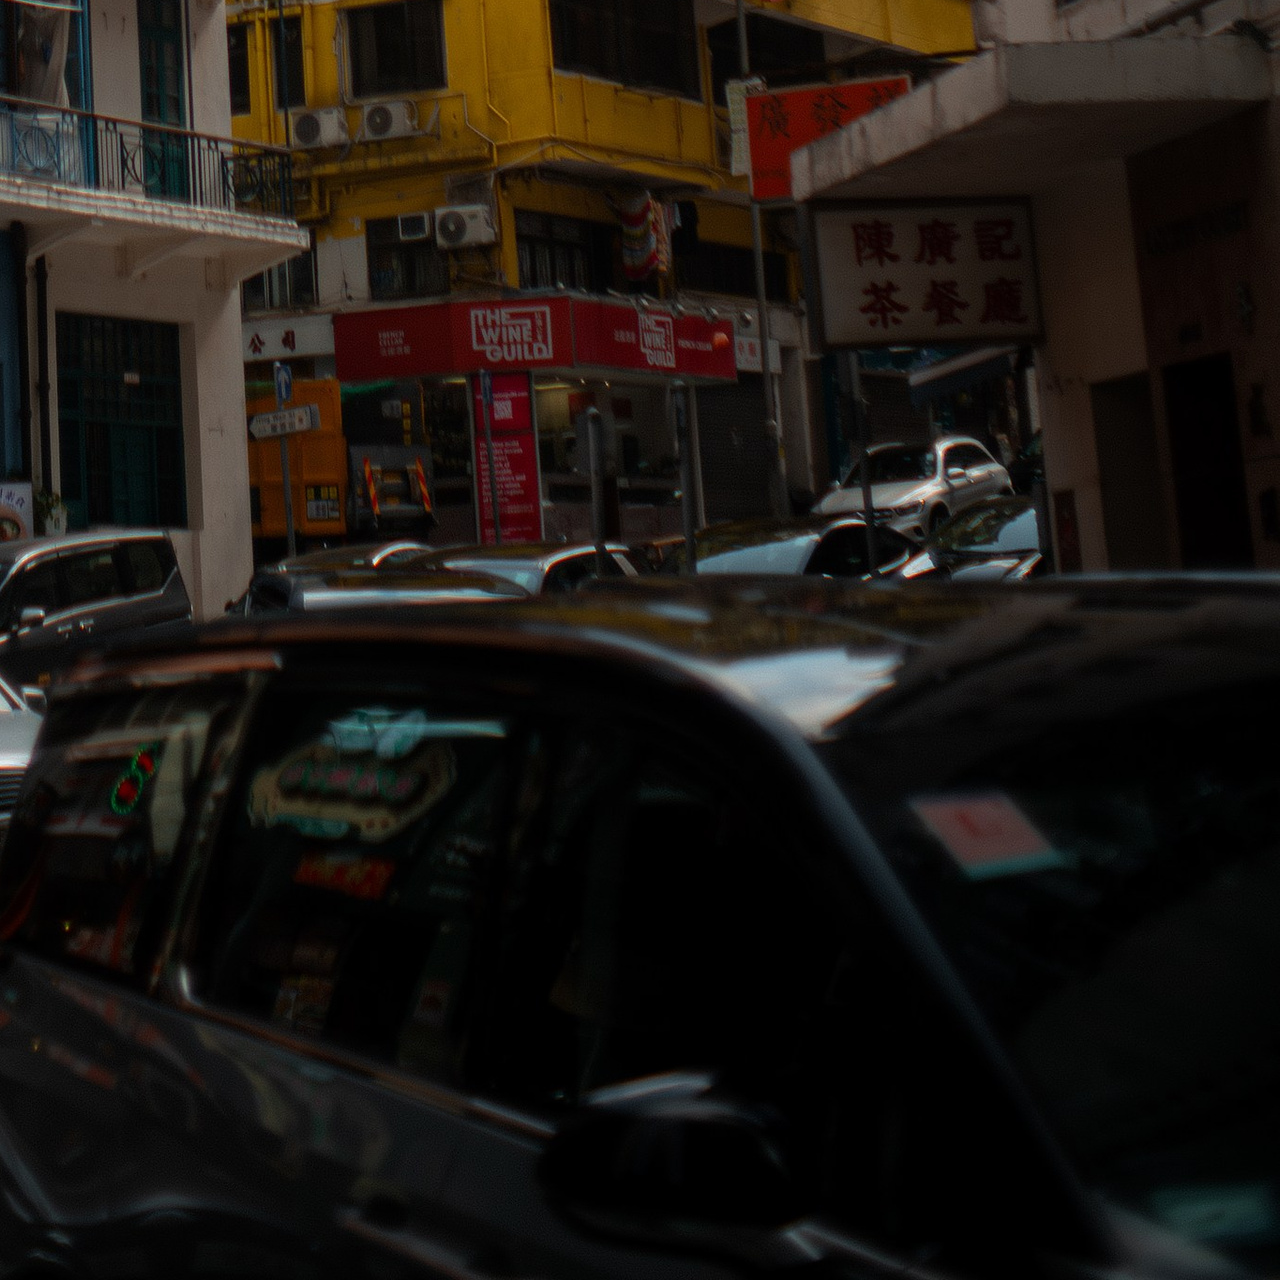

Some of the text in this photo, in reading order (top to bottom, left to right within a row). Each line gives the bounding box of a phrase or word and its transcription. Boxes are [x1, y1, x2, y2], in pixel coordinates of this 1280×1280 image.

[852, 219, 1022, 267] 陳廣記
[860, 276, 1029, 330] 茶餐廳
[471, 306, 511, 327] THE
[249, 329, 296, 356] 公司
[481, 324, 533, 344] WINE
[485, 341, 552, 362] GUILD
[646, 348, 676, 368] GUILD
